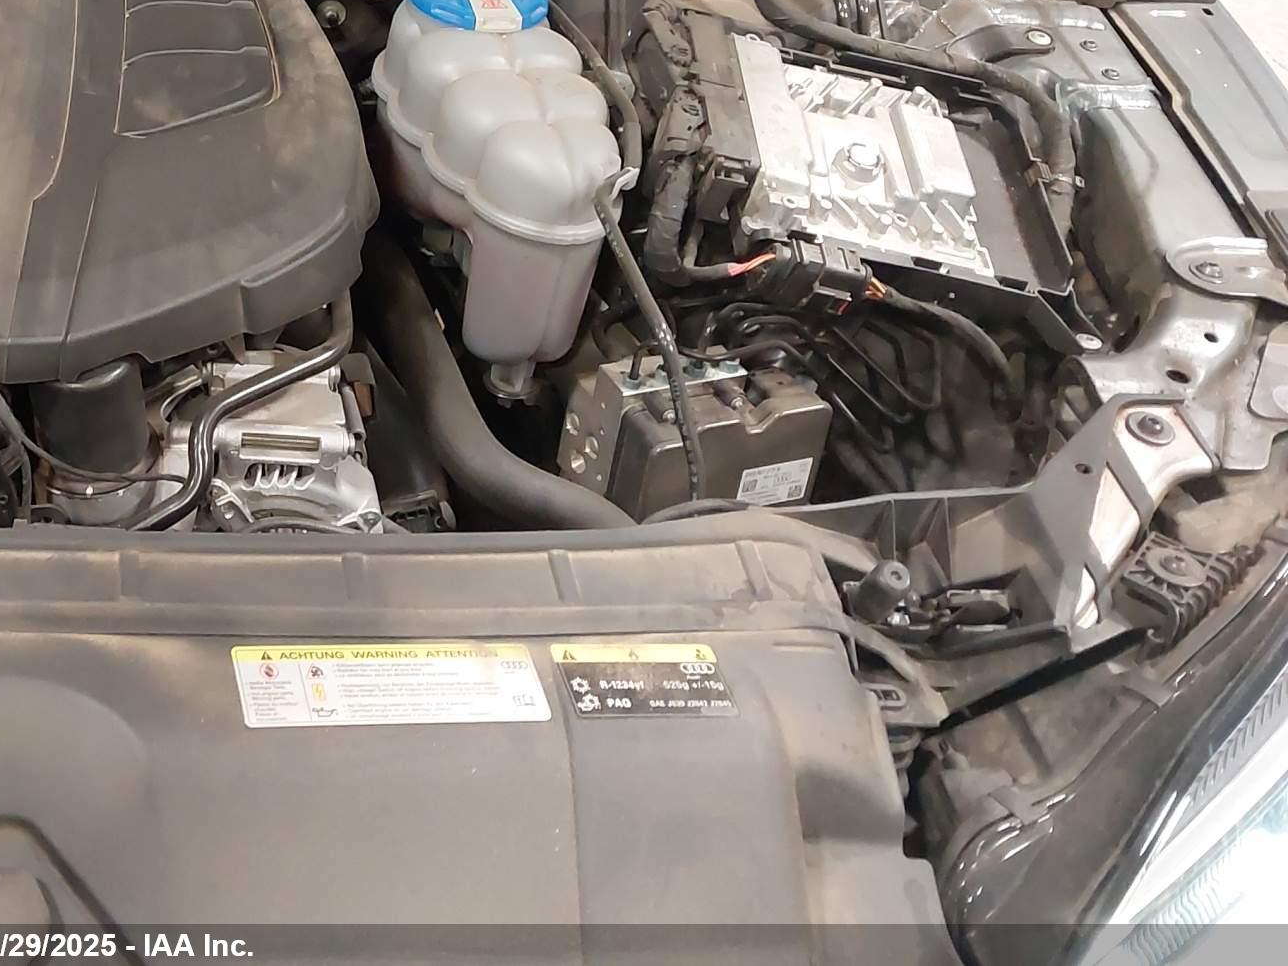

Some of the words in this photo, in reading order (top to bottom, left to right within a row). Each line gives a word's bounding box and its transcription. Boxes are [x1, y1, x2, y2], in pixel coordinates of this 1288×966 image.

[279, 650, 345, 660] ACHTUNG
[351, 650, 418, 659] WARNING
[426, 649, 499, 659] ATTENTION
